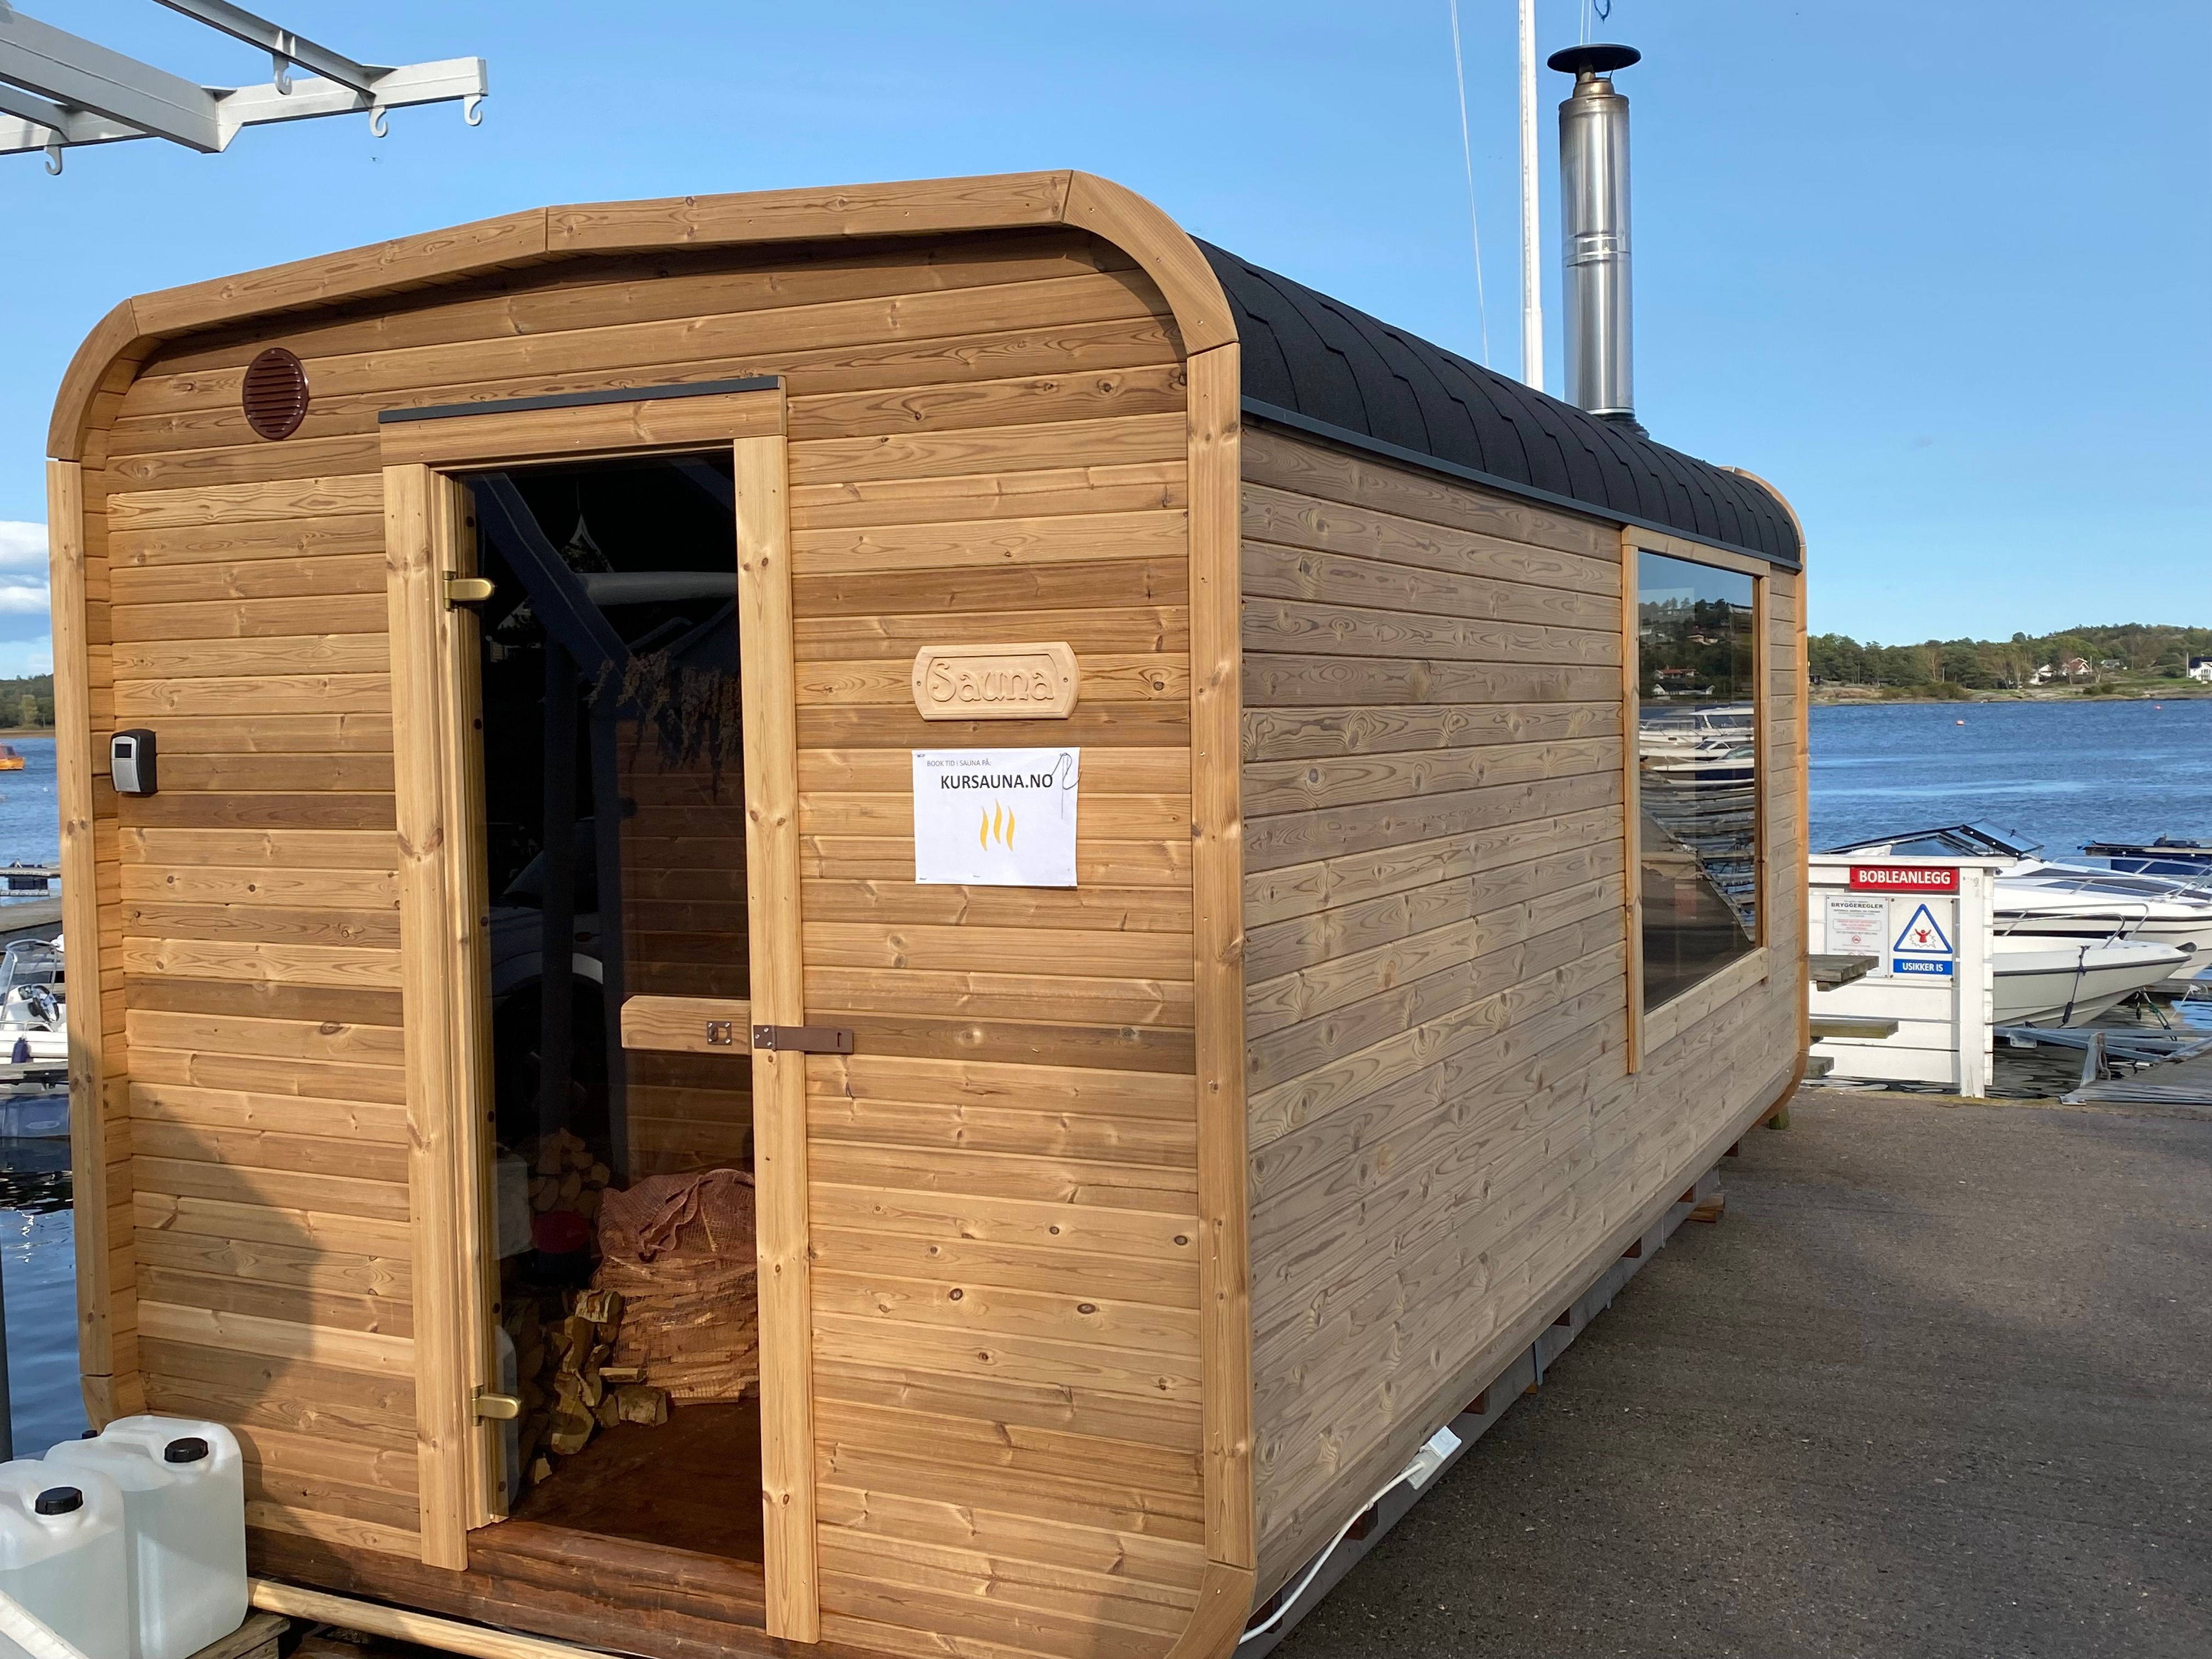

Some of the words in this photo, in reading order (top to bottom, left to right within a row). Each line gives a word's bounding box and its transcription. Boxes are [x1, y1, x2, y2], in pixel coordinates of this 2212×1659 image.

[930, 662, 1054, 702] Sauna
[940, 774, 1053, 789] KURSAUNA.NO
[1859, 870, 1951, 884] BOBLEANLEGG
[1902, 962, 1934, 972] USIKKER
[1936, 963, 1944, 972] IS
